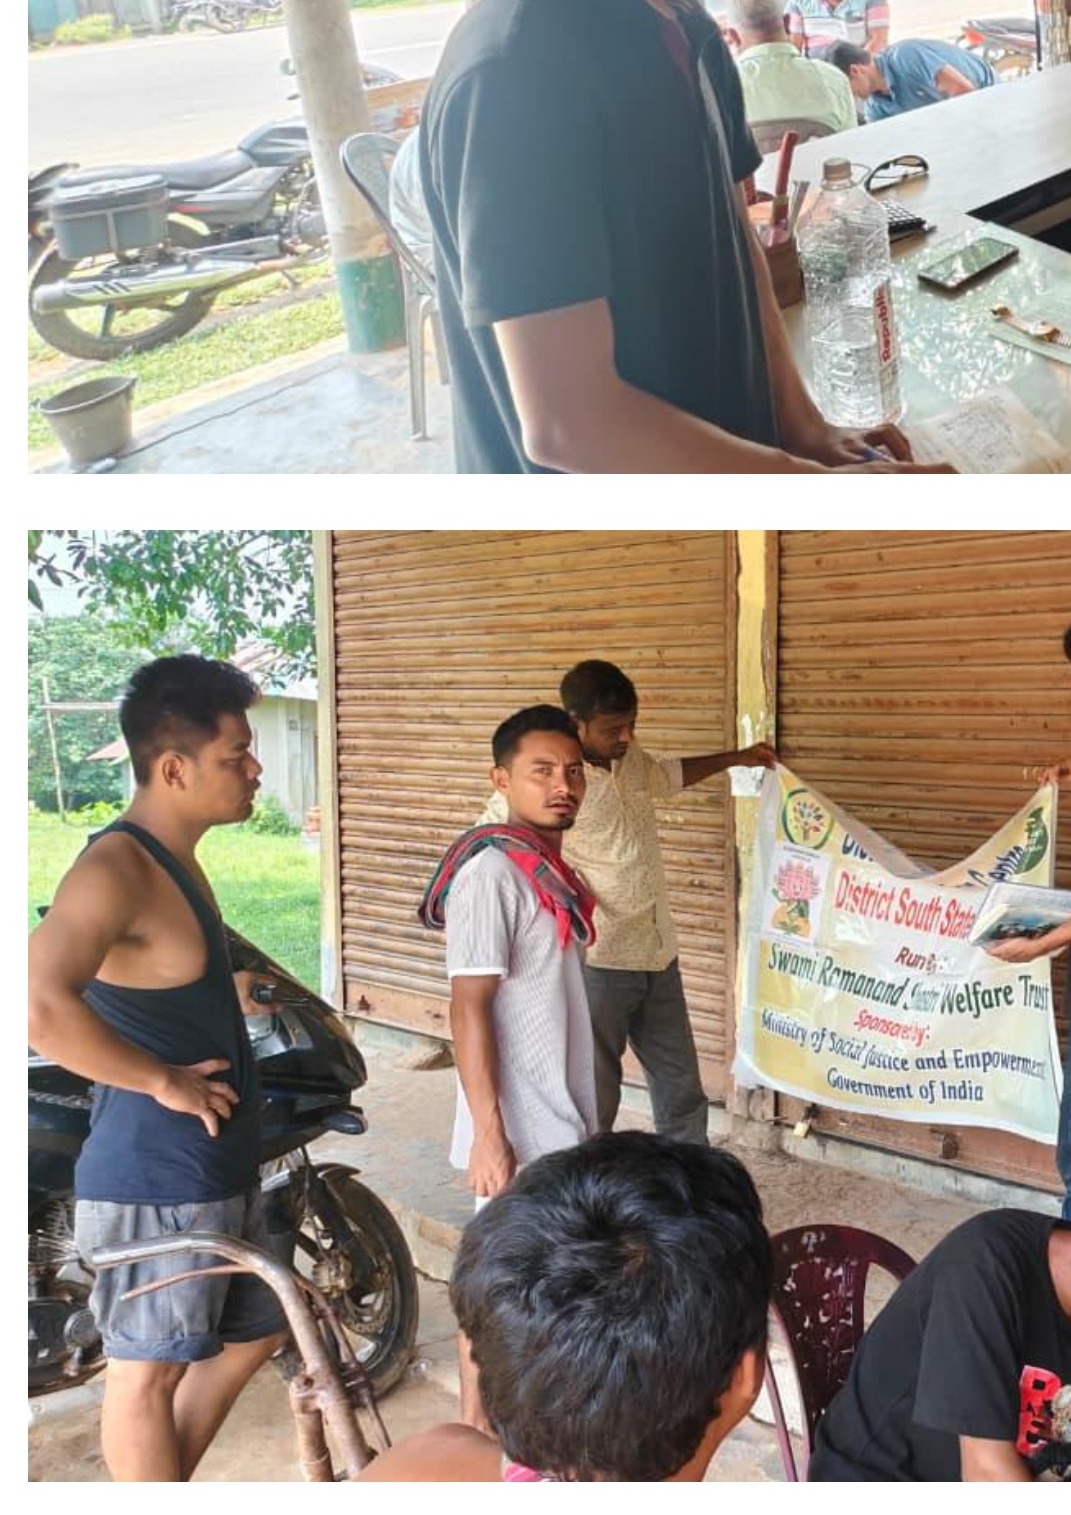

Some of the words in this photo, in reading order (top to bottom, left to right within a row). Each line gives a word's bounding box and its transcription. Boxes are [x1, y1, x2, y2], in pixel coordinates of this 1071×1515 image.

[835, 870, 895, 921] District
[894, 887, 943, 933] South
[768, 941, 819, 983] Swami
[818, 954, 907, 1008] Ramanand
[940, 980, 1015, 1020] Welfare
[1018, 974, 1051, 1013] Trust
[894, 945, 925, 972] Run
[761, 1007, 808, 1048] Ministry
[811, 1027, 828, 1054] of
[828, 1031, 865, 1063] Social
[862, 1041, 910, 1072] Justice
[915, 1050, 948, 1071] and
[826, 1066, 914, 1100] Government
[919, 1081, 938, 1105] of
[940, 1080, 985, 1102] India
